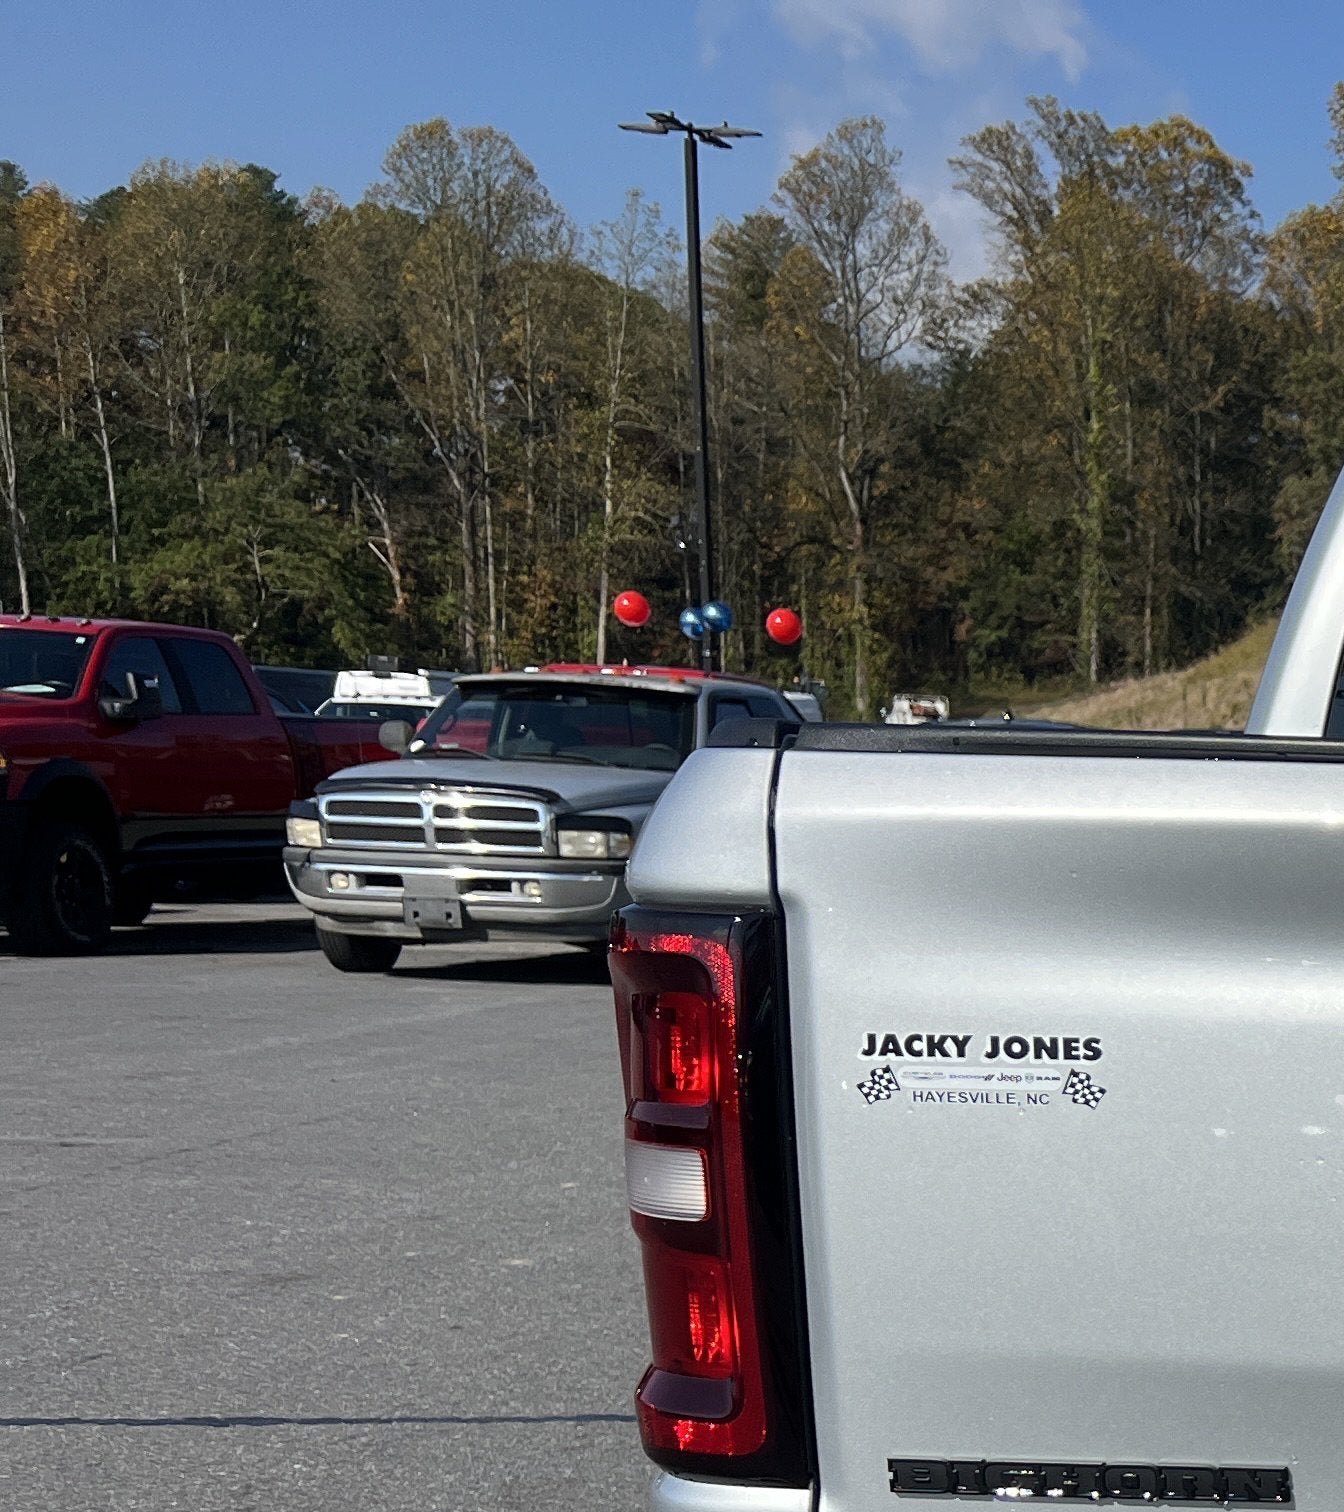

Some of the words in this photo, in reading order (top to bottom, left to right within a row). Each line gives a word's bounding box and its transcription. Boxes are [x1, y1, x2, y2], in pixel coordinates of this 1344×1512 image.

[861, 1033, 973, 1058] JACKY
[984, 1035, 1103, 1061] JONES
[997, 1073, 1022, 1083] Jeep
[912, 1091, 1021, 1106] HAYESVILLE,
[1027, 1093, 1050, 1105] NC
